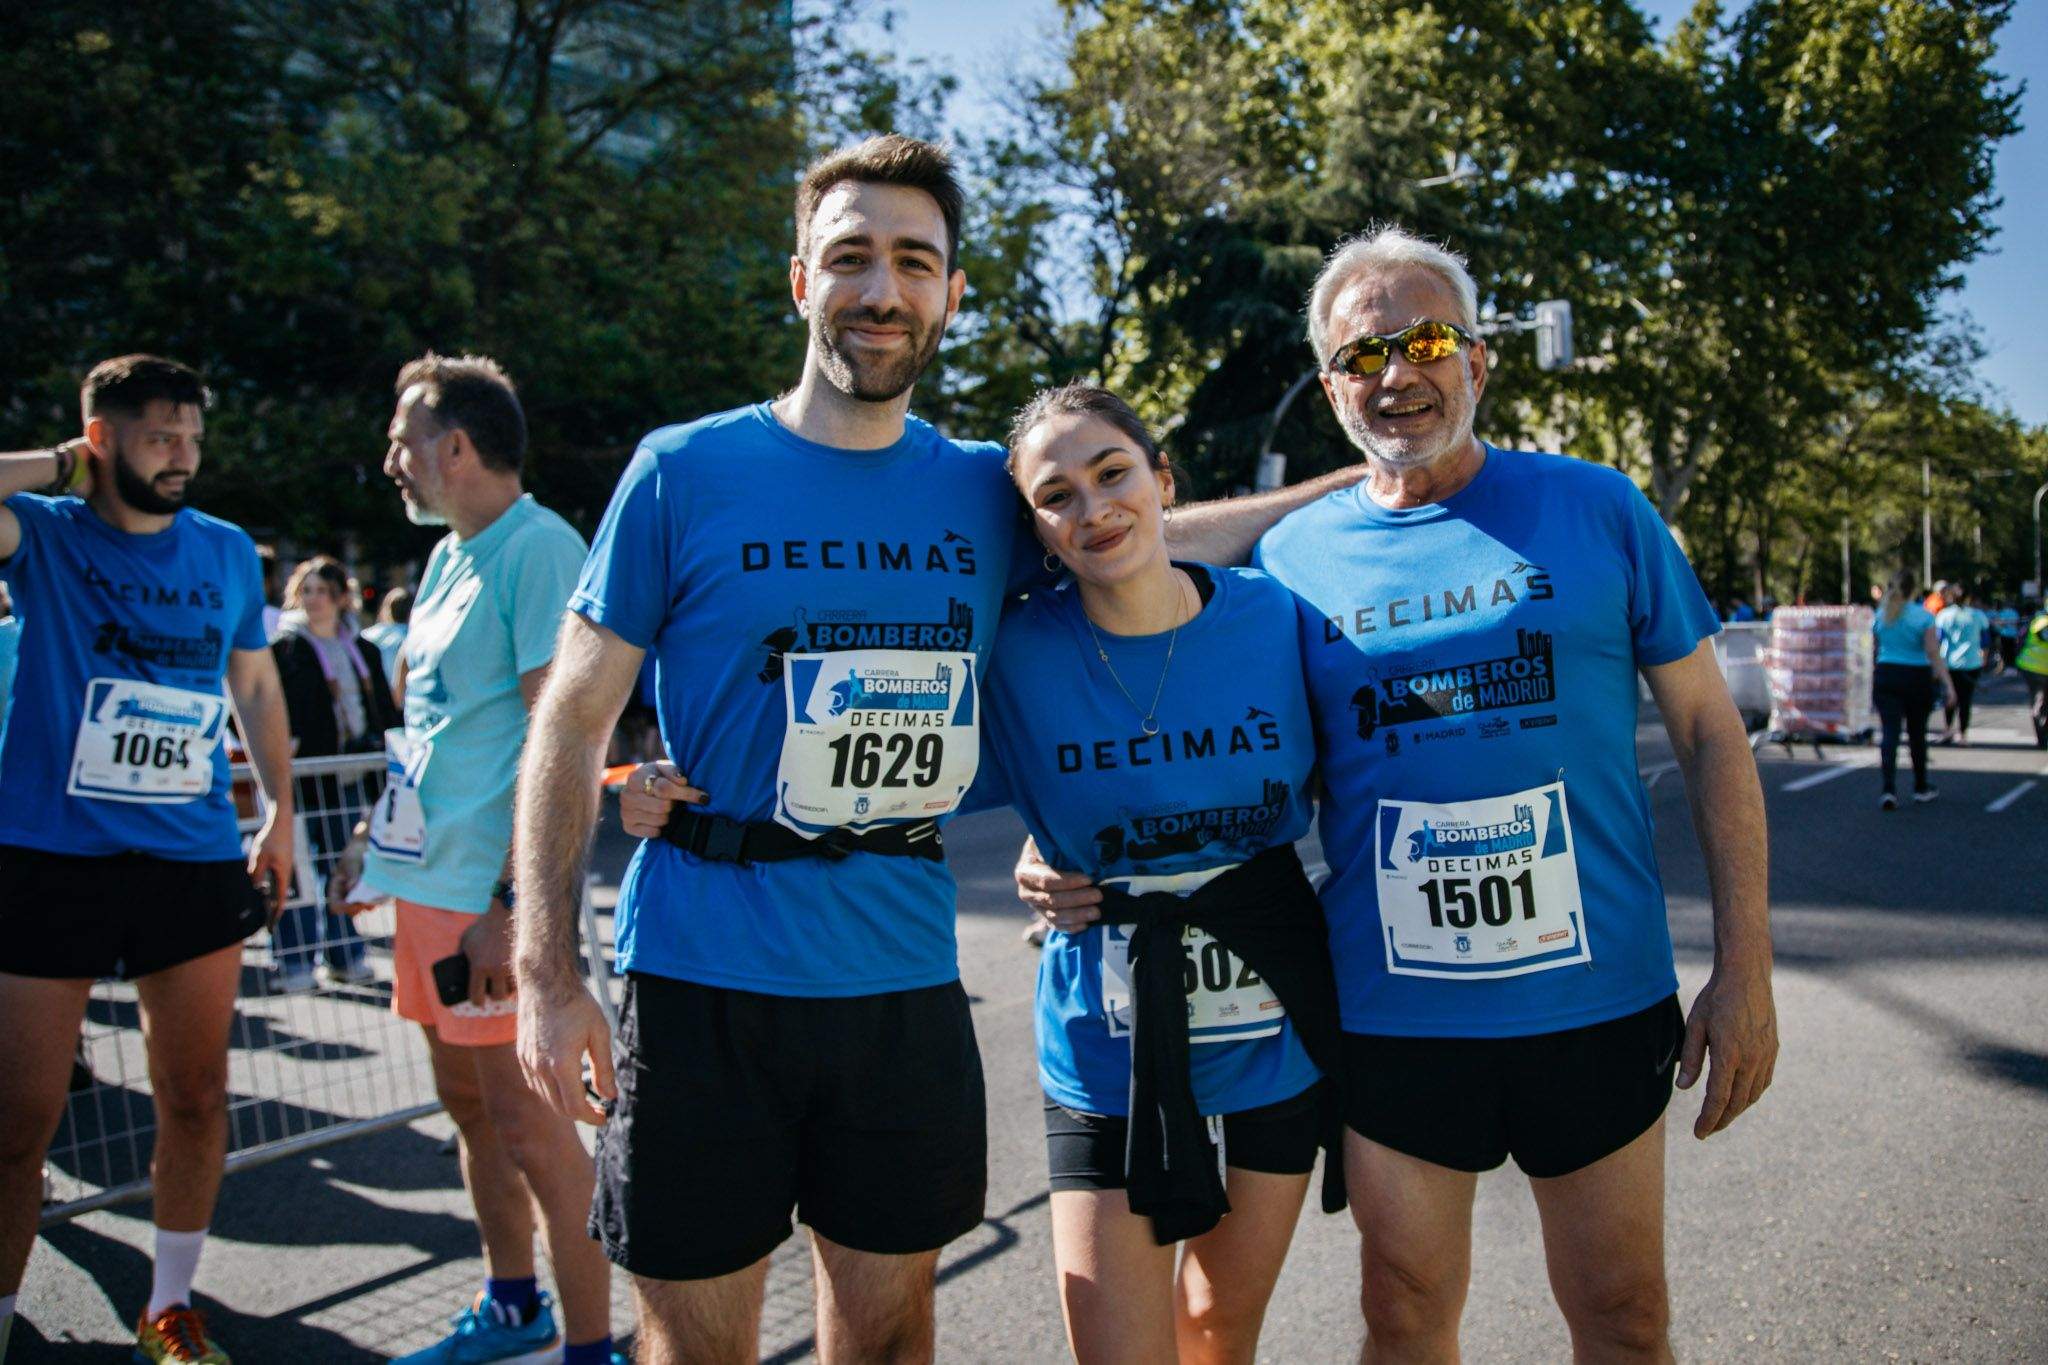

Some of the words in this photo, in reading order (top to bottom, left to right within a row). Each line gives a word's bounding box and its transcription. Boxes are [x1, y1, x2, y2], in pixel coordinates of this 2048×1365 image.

[743, 541, 977, 576] DECIMAS
[1324, 574, 1554, 645] DECIMAS
[816, 626, 969, 648] BOMBEROS
[864, 678, 949, 695] BOMBEROS
[1391, 656, 1547, 699] BOMBEROS
[1452, 690, 1475, 713] de
[1479, 677, 1550, 707] MADRID
[851, 711, 945, 728] DECIMAS
[829, 733, 944, 789] 1629
[1057, 721, 1281, 774] DECIMAS
[1142, 803, 1281, 838] BOMBEROS
[1435, 819, 1532, 843] BOMBEROS
[1428, 849, 1533, 873] DECIMAS
[1418, 869, 1537, 930] 1501
